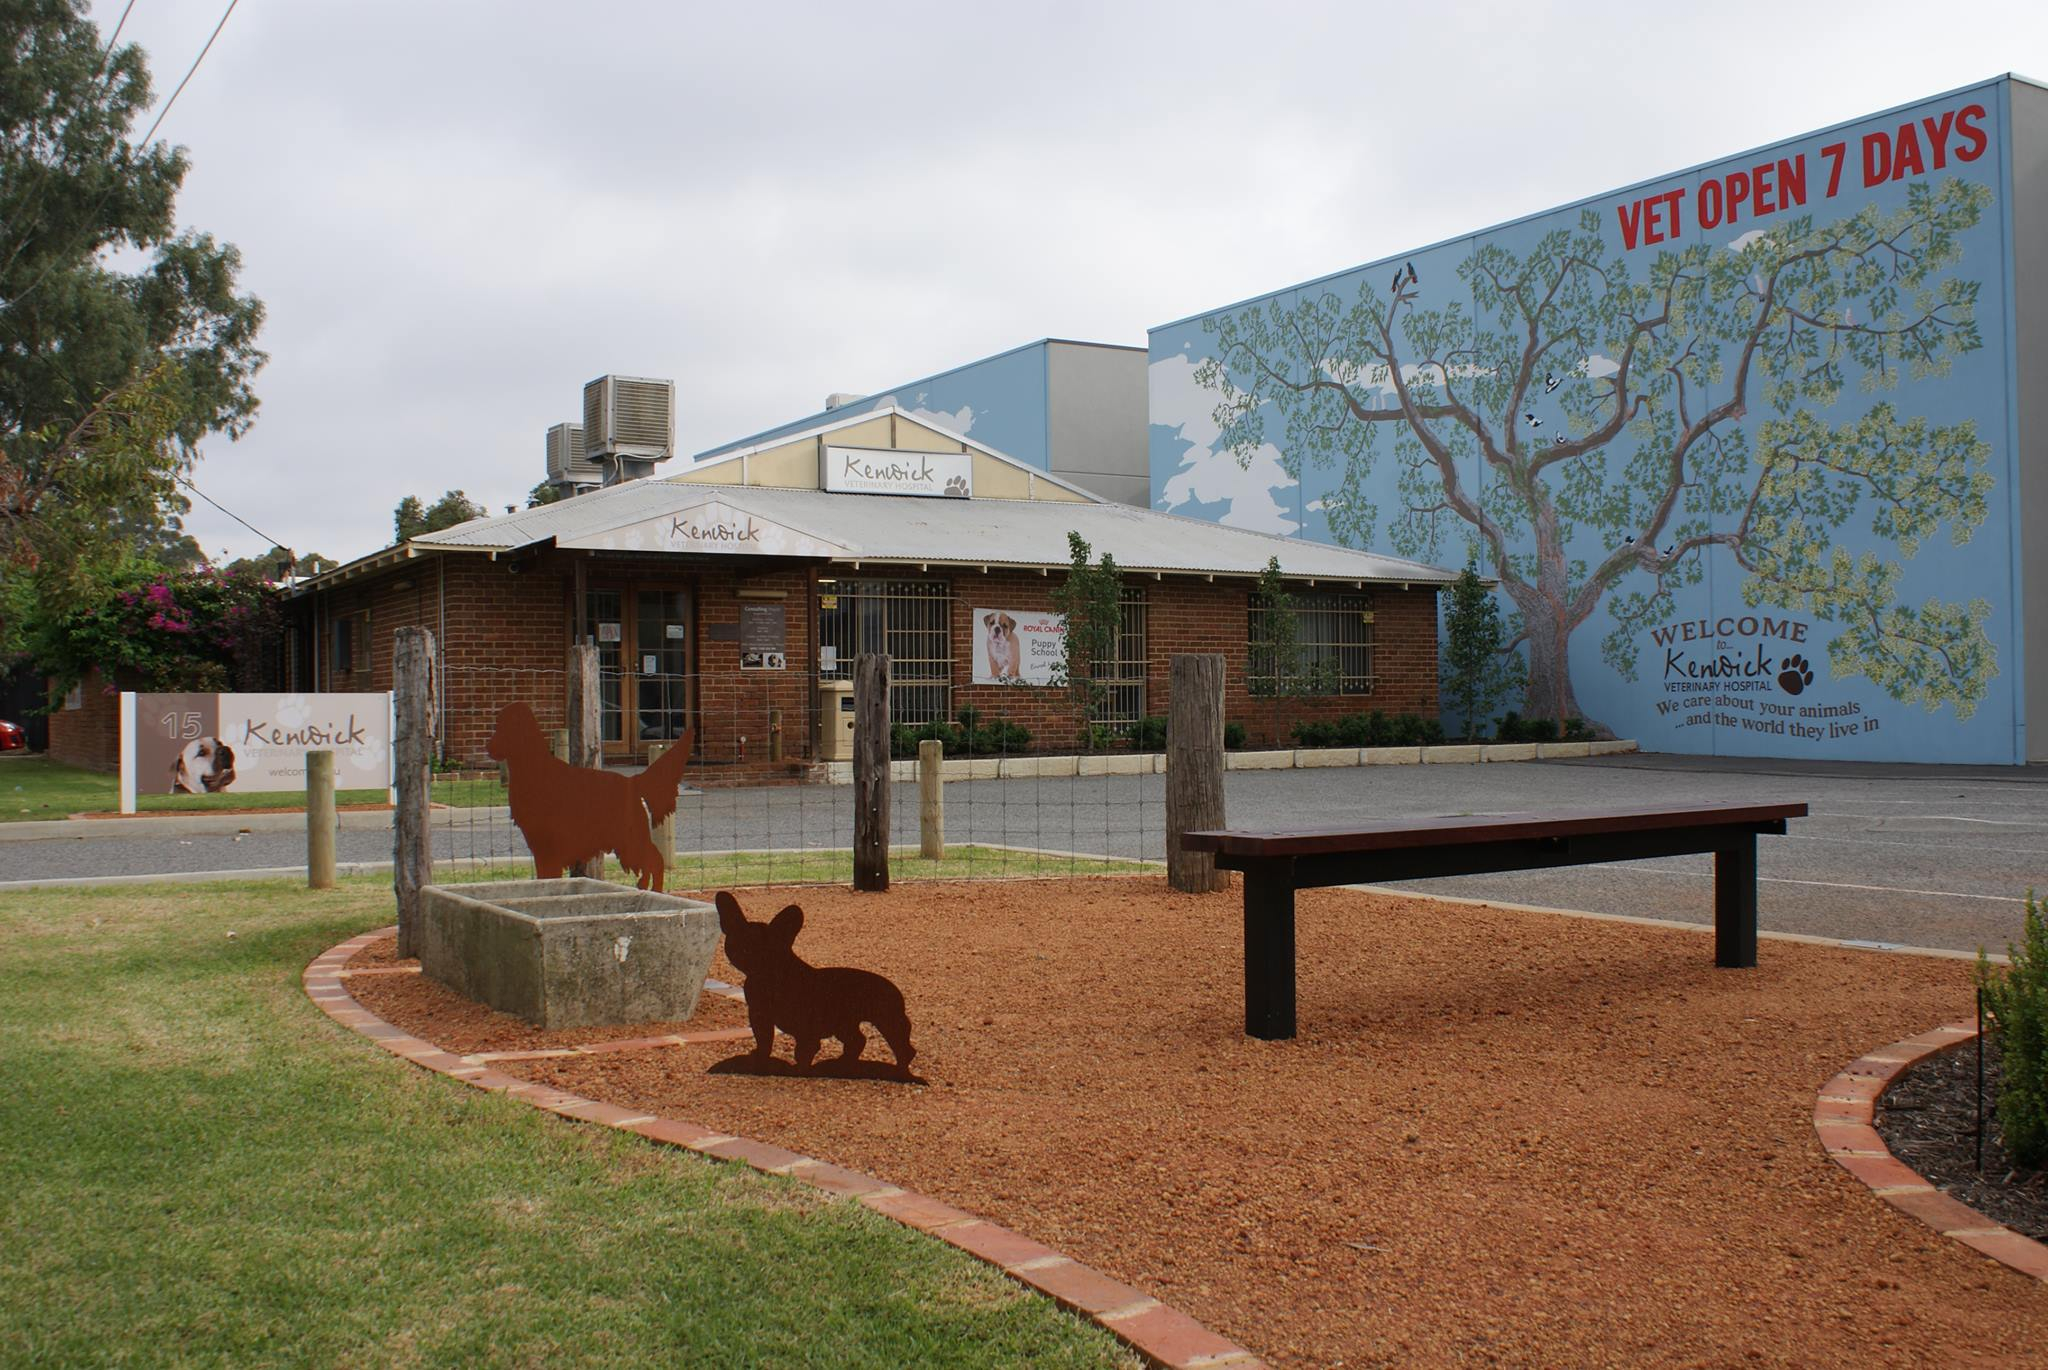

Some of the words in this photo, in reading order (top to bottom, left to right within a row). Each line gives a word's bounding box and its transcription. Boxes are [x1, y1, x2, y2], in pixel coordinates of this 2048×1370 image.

[1617, 188, 1685, 251] VET
[1697, 153, 1807, 230] OPEN
[1820, 141, 1846, 198] 7
[1862, 104, 1988, 188] DAYS
[844, 455, 934, 483] Kenwick
[670, 517, 759, 542] Kenwick
[1023, 625, 1043, 633] ROYAL
[1651, 616, 1809, 649] WELCOME
[1031, 639, 1057, 649] Puppy
[1031, 648, 1058, 657] School
[1664, 643, 1773, 680] Kenwick
[1664, 681, 1720, 693] VETERINARY
[1723, 681, 1773, 691] HOSPITAL
[1656, 700, 1679, 717] We
[1683, 695, 1711, 709] care
[1715, 695, 1754, 711] about
[1759, 701, 1795, 717] your
[1799, 701, 1861, 718] animals
[161, 712, 202, 740] 15
[243, 714, 365, 746] Kenwick
[1714, 712, 1737, 727] the
[1742, 718, 1785, 734] world
[1789, 723, 1825, 741] they
[1829, 721, 1859, 738] live
[1864, 716, 1879, 732] in
